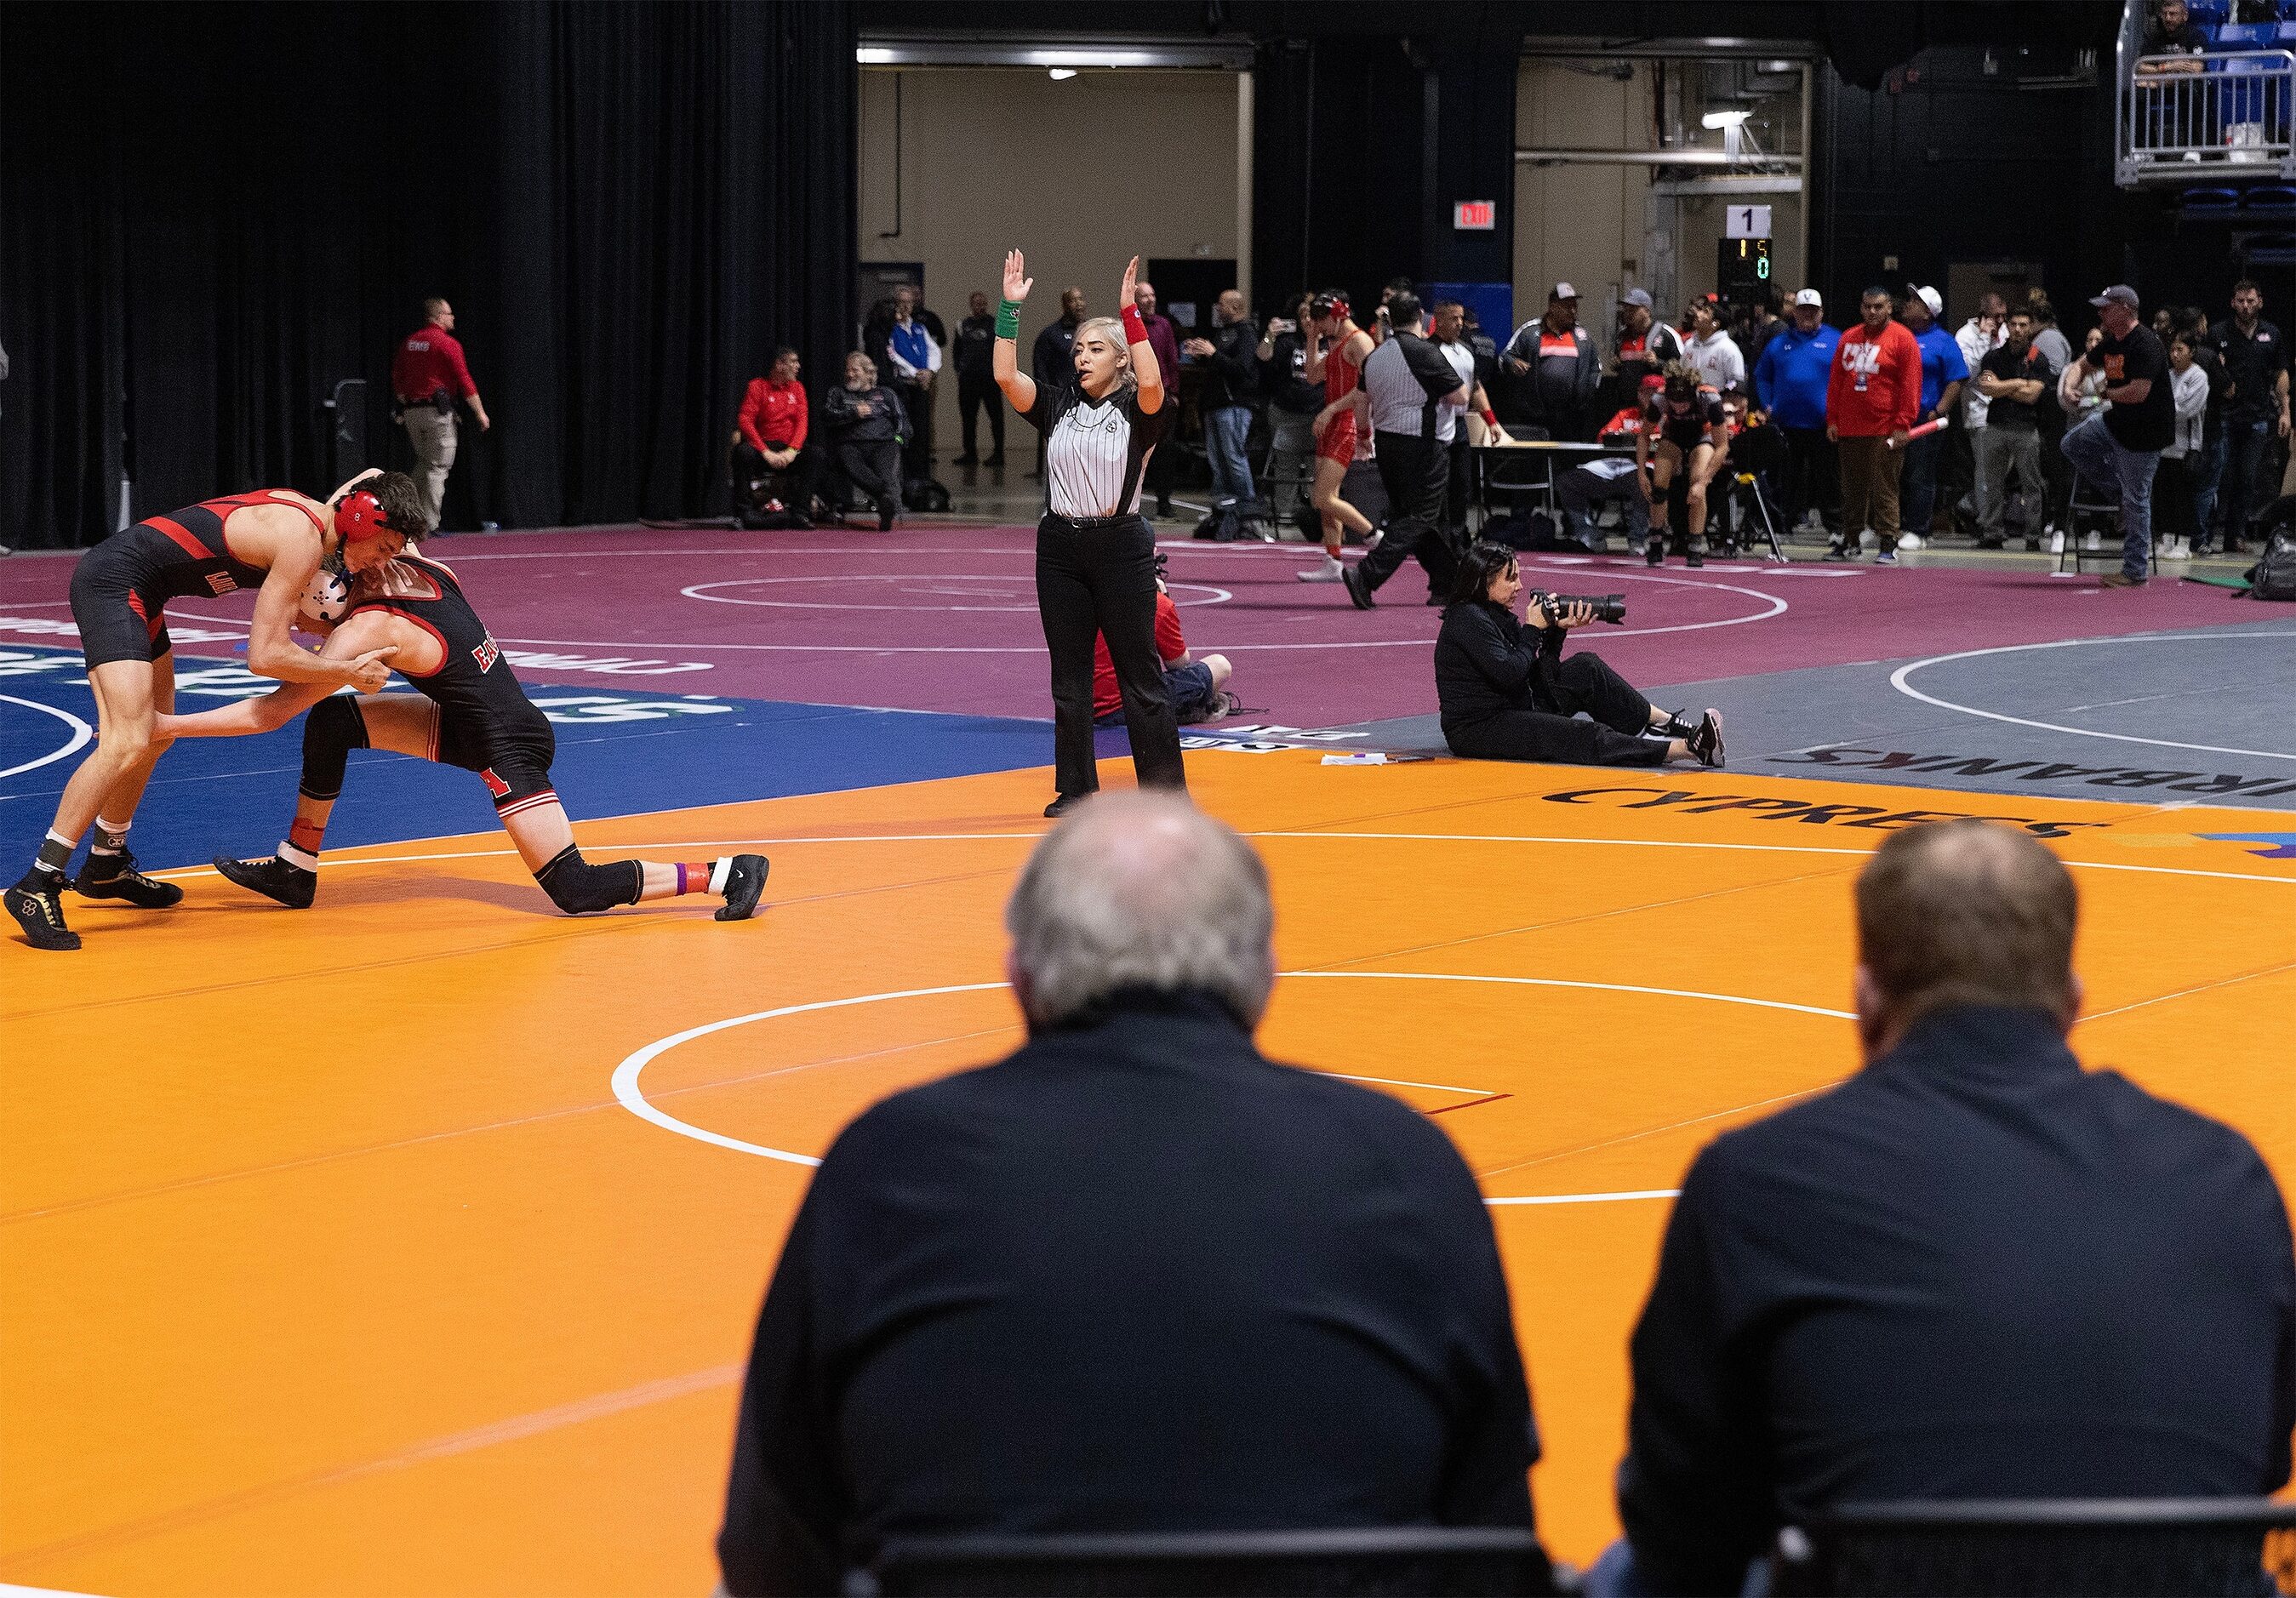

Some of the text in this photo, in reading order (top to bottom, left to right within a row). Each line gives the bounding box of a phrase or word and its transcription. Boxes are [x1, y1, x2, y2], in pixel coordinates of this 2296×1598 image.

[1461, 203, 1489, 225] EXIT
[1742, 208, 1752, 231] 1
[1757, 257, 1769, 279] 0
